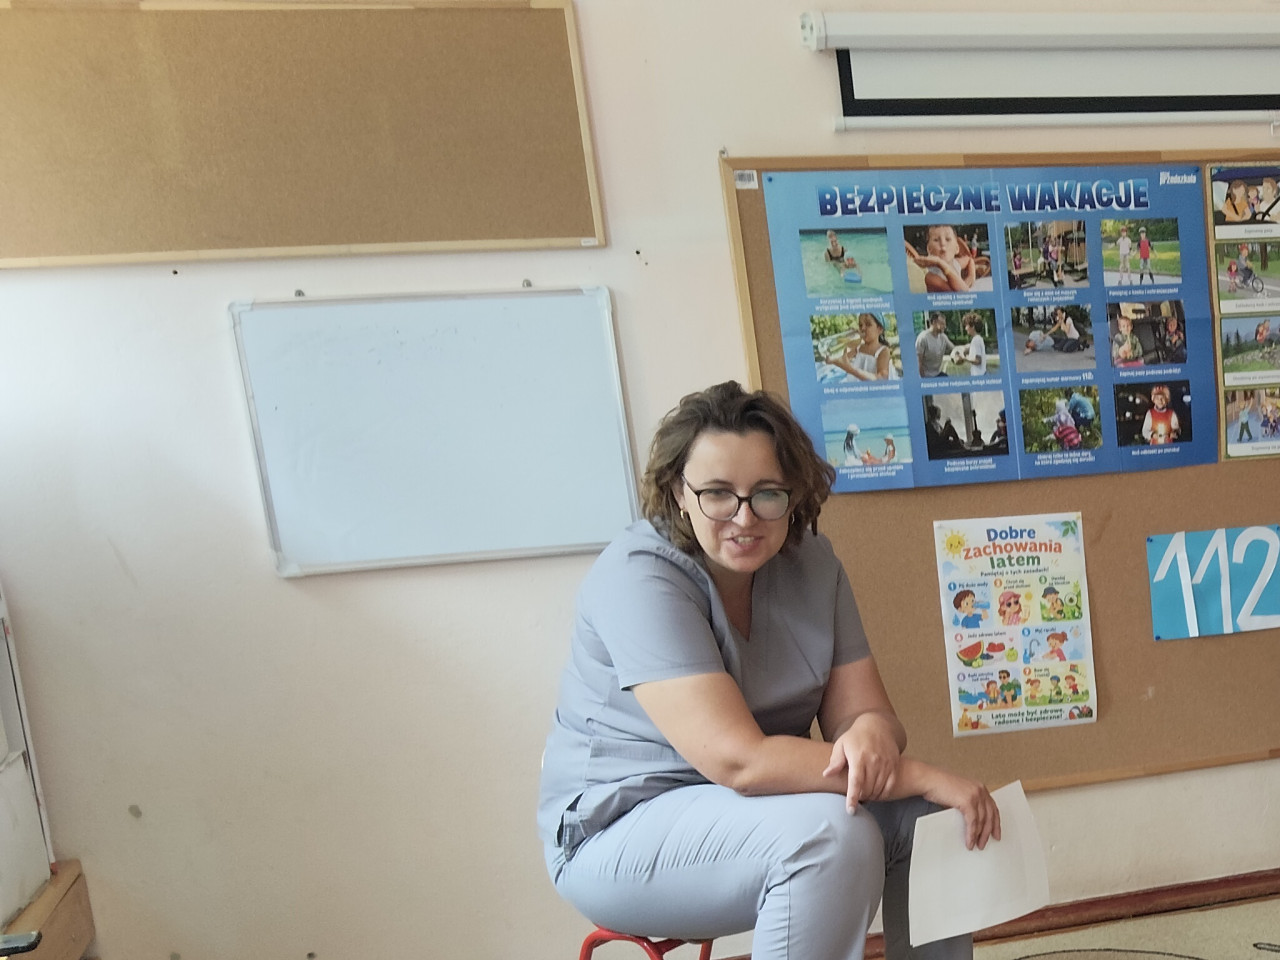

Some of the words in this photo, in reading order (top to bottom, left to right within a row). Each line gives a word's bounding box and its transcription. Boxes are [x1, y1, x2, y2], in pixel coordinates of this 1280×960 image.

[817, 181, 1001, 216] BEZPIECZNE
[1006, 178, 1150, 213] WAKACJE
[986, 526, 1036, 542] Dobre
[963, 540, 1062, 561] zachowania
[989, 554, 1041, 570] latem
[1025, 714, 1063, 723] bezpieczne!
[1026, 709, 1037, 717] być
